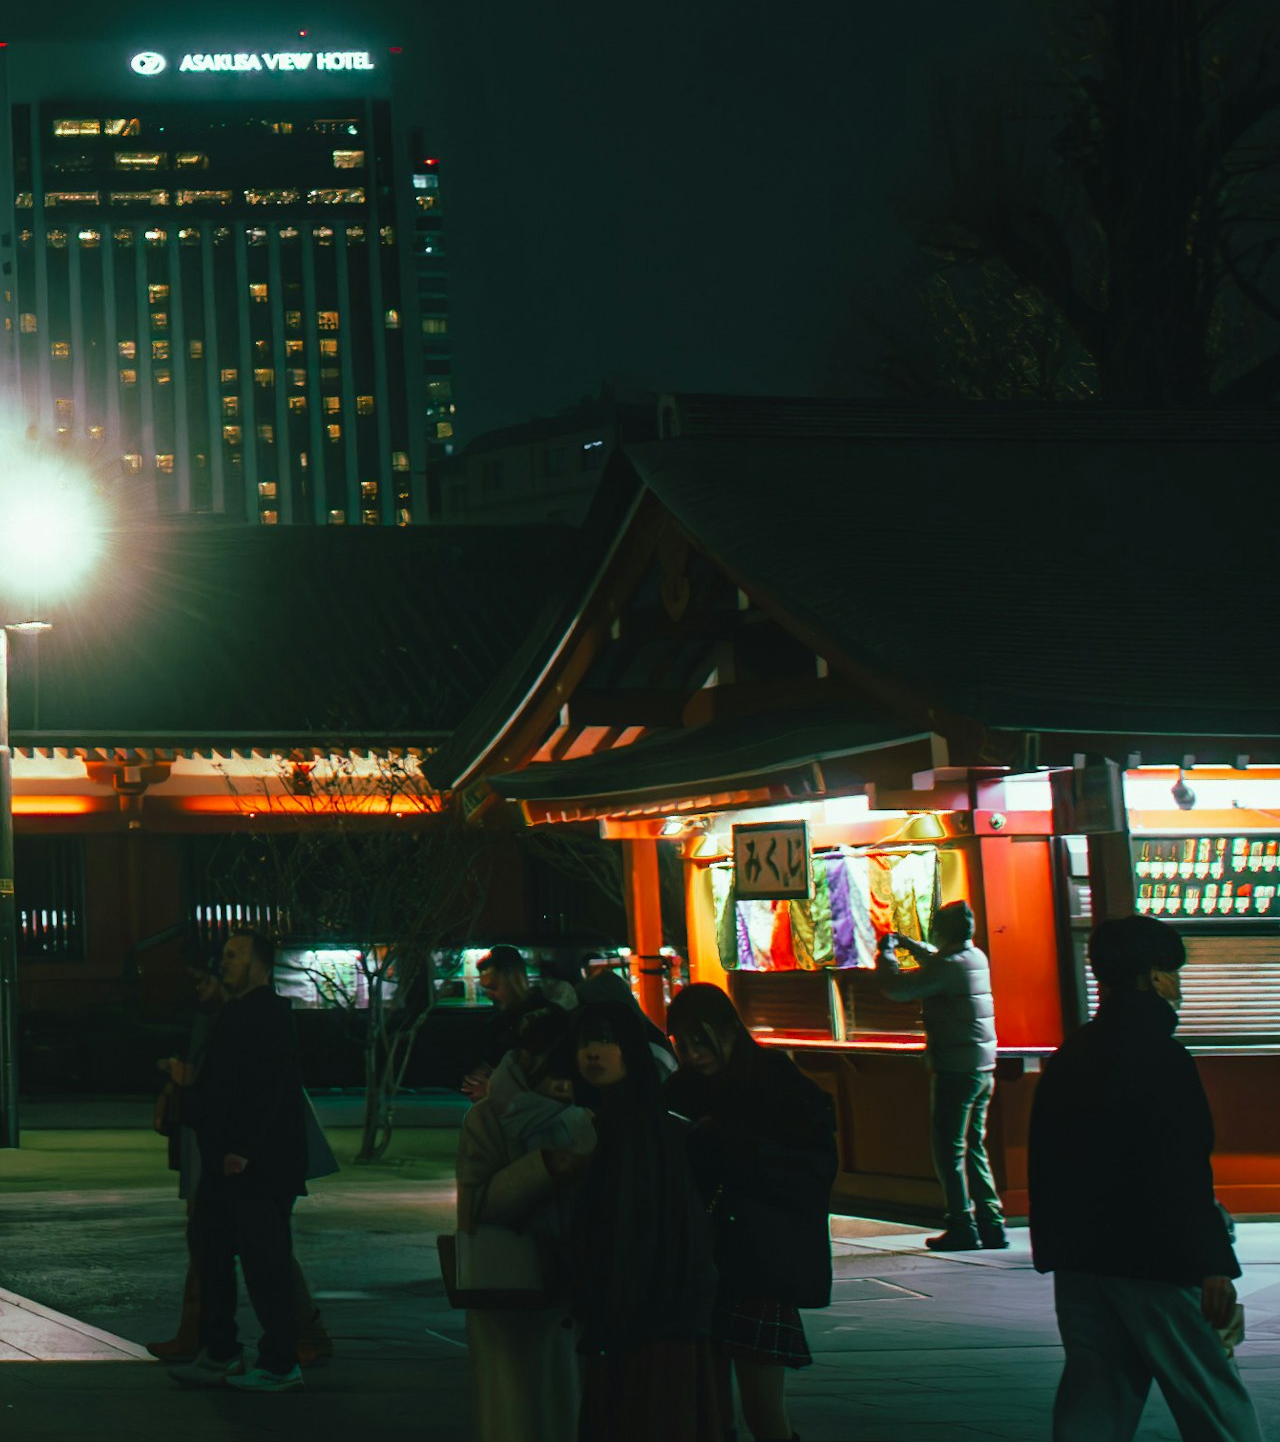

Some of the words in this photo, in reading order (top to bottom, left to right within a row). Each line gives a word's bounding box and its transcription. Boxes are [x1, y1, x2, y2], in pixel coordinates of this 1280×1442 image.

[179, 53, 262, 72] ASAKUSA
[262, 53, 313, 71] VIEW
[316, 52, 375, 70] HOTEL
